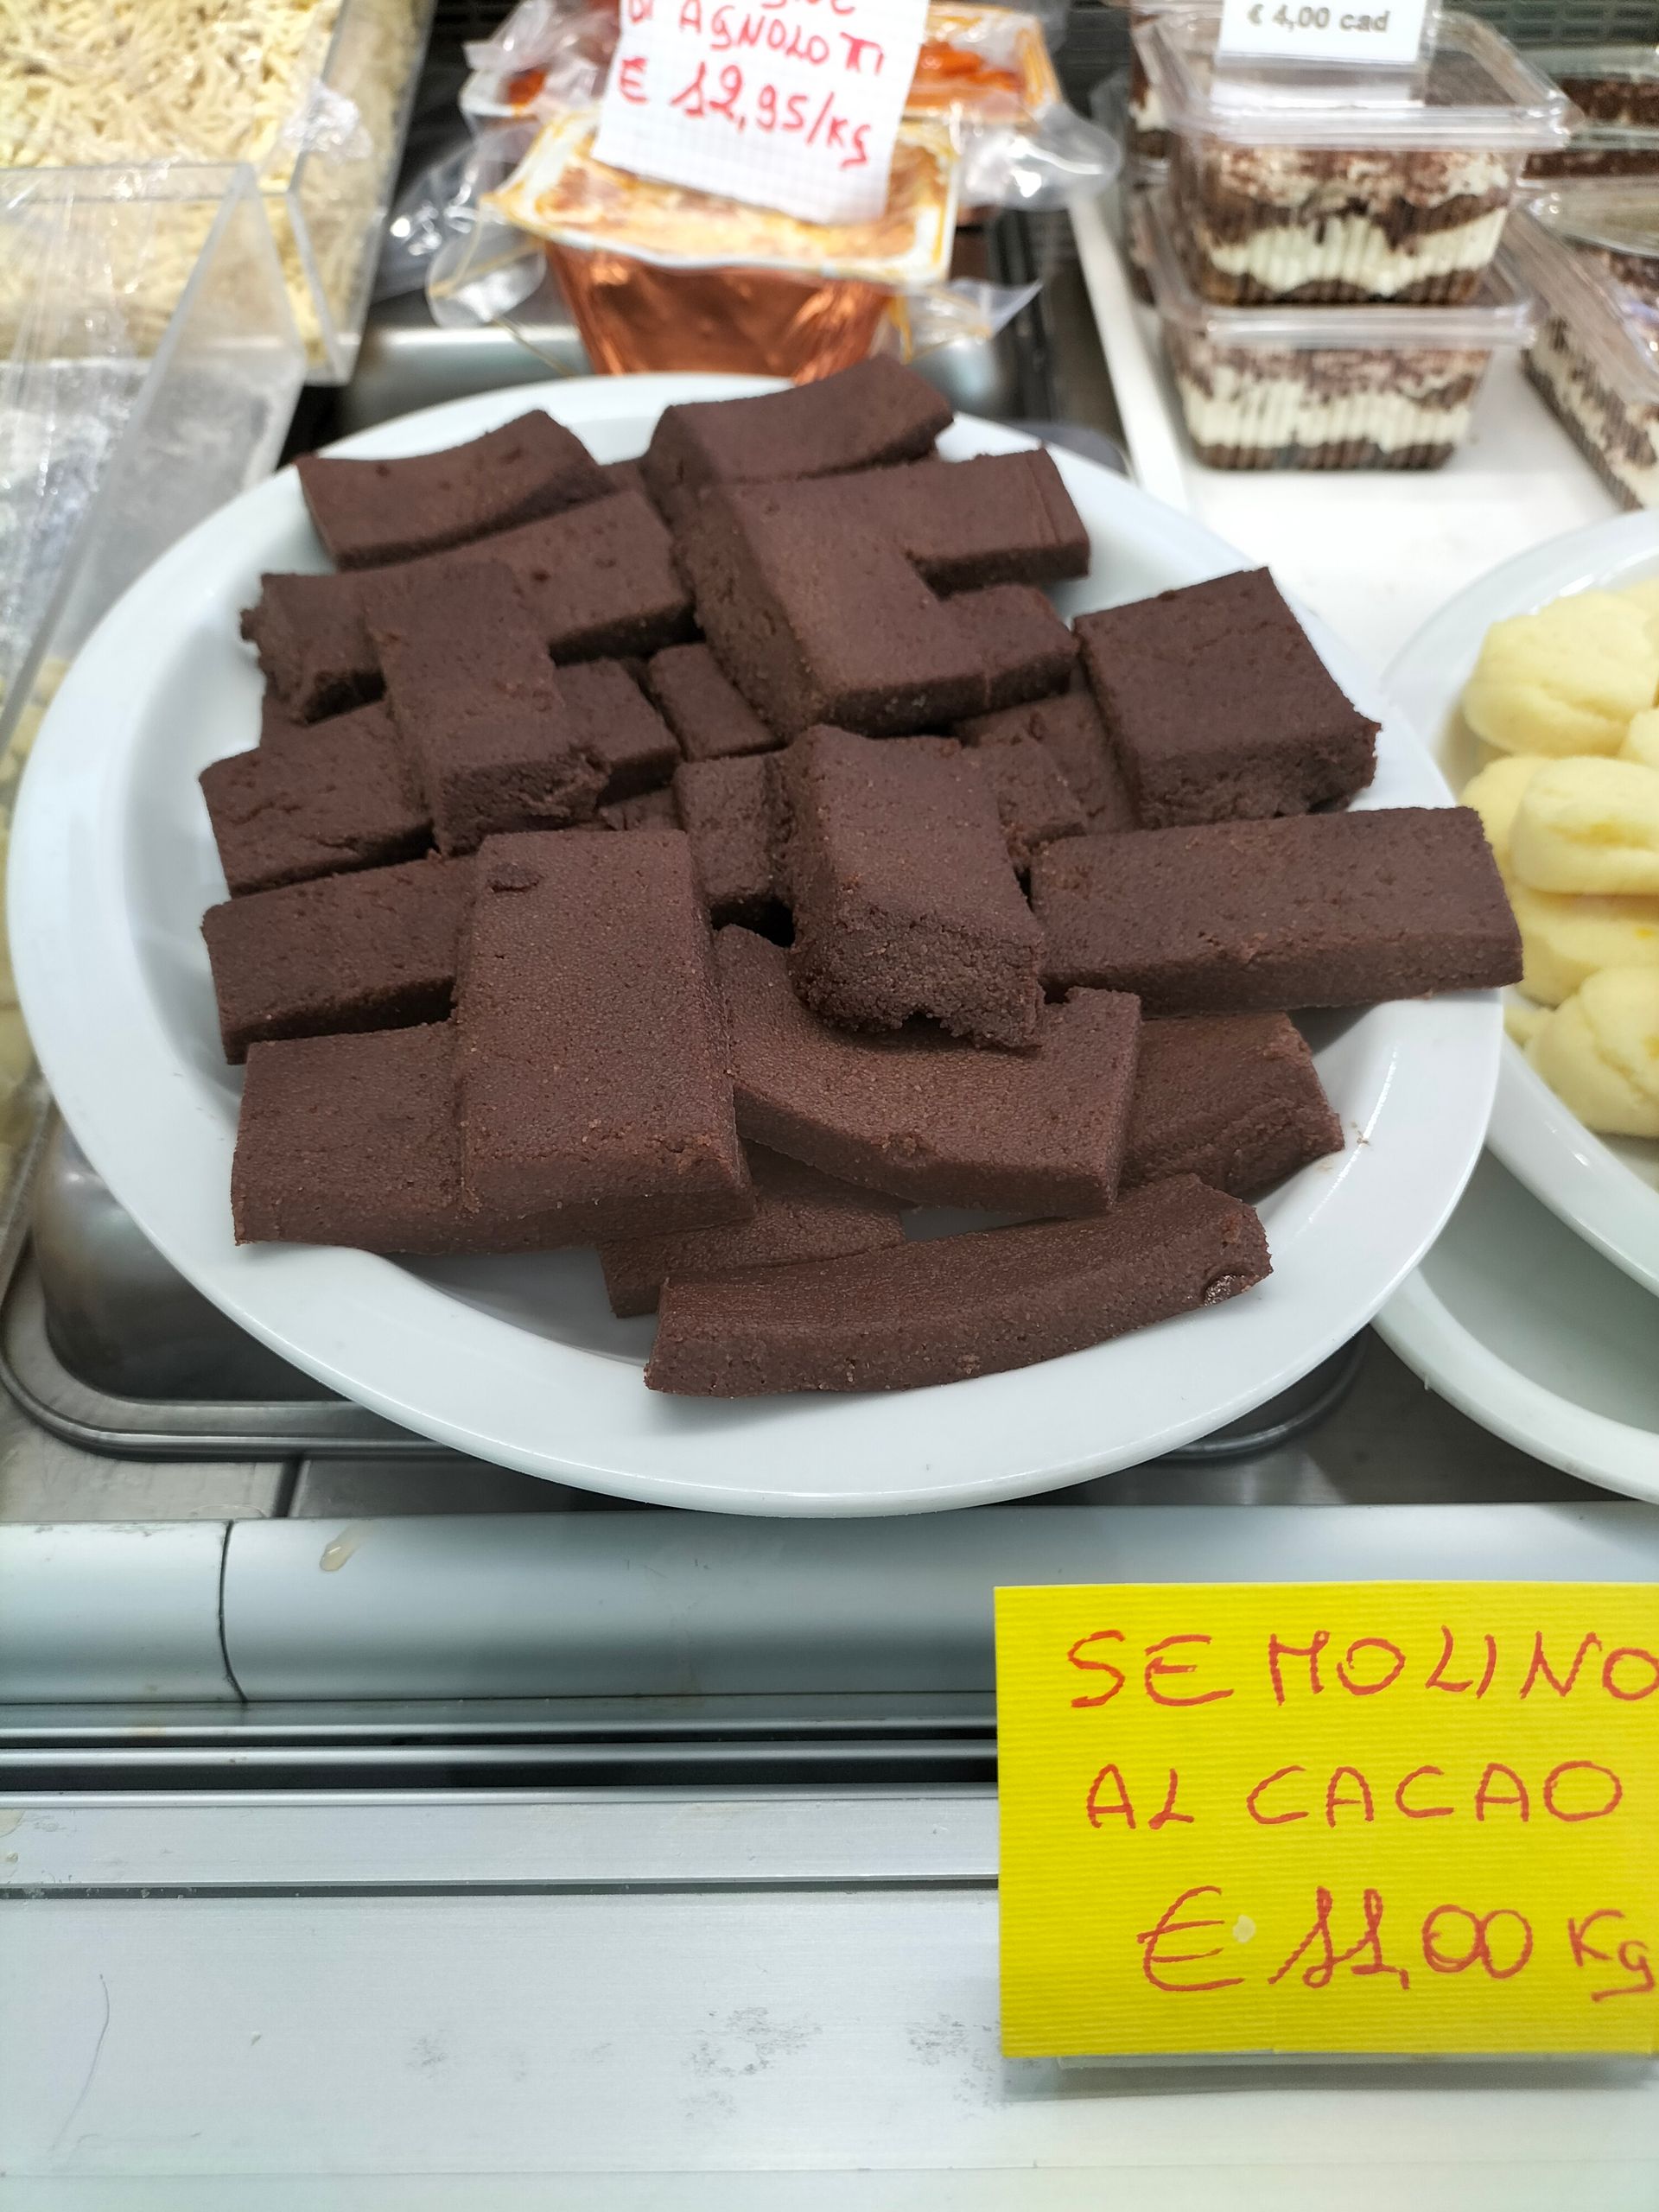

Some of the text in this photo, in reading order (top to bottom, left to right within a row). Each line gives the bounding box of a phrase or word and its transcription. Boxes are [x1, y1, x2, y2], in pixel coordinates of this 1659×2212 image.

[1272, 4, 1332, 32] 4,00
[1339, 10, 1390, 32] cad
[1086, 1759, 1624, 1831] AL CACAO
[1136, 1885, 1244, 1992] €
[1268, 1885, 1535, 1991] 11,00
